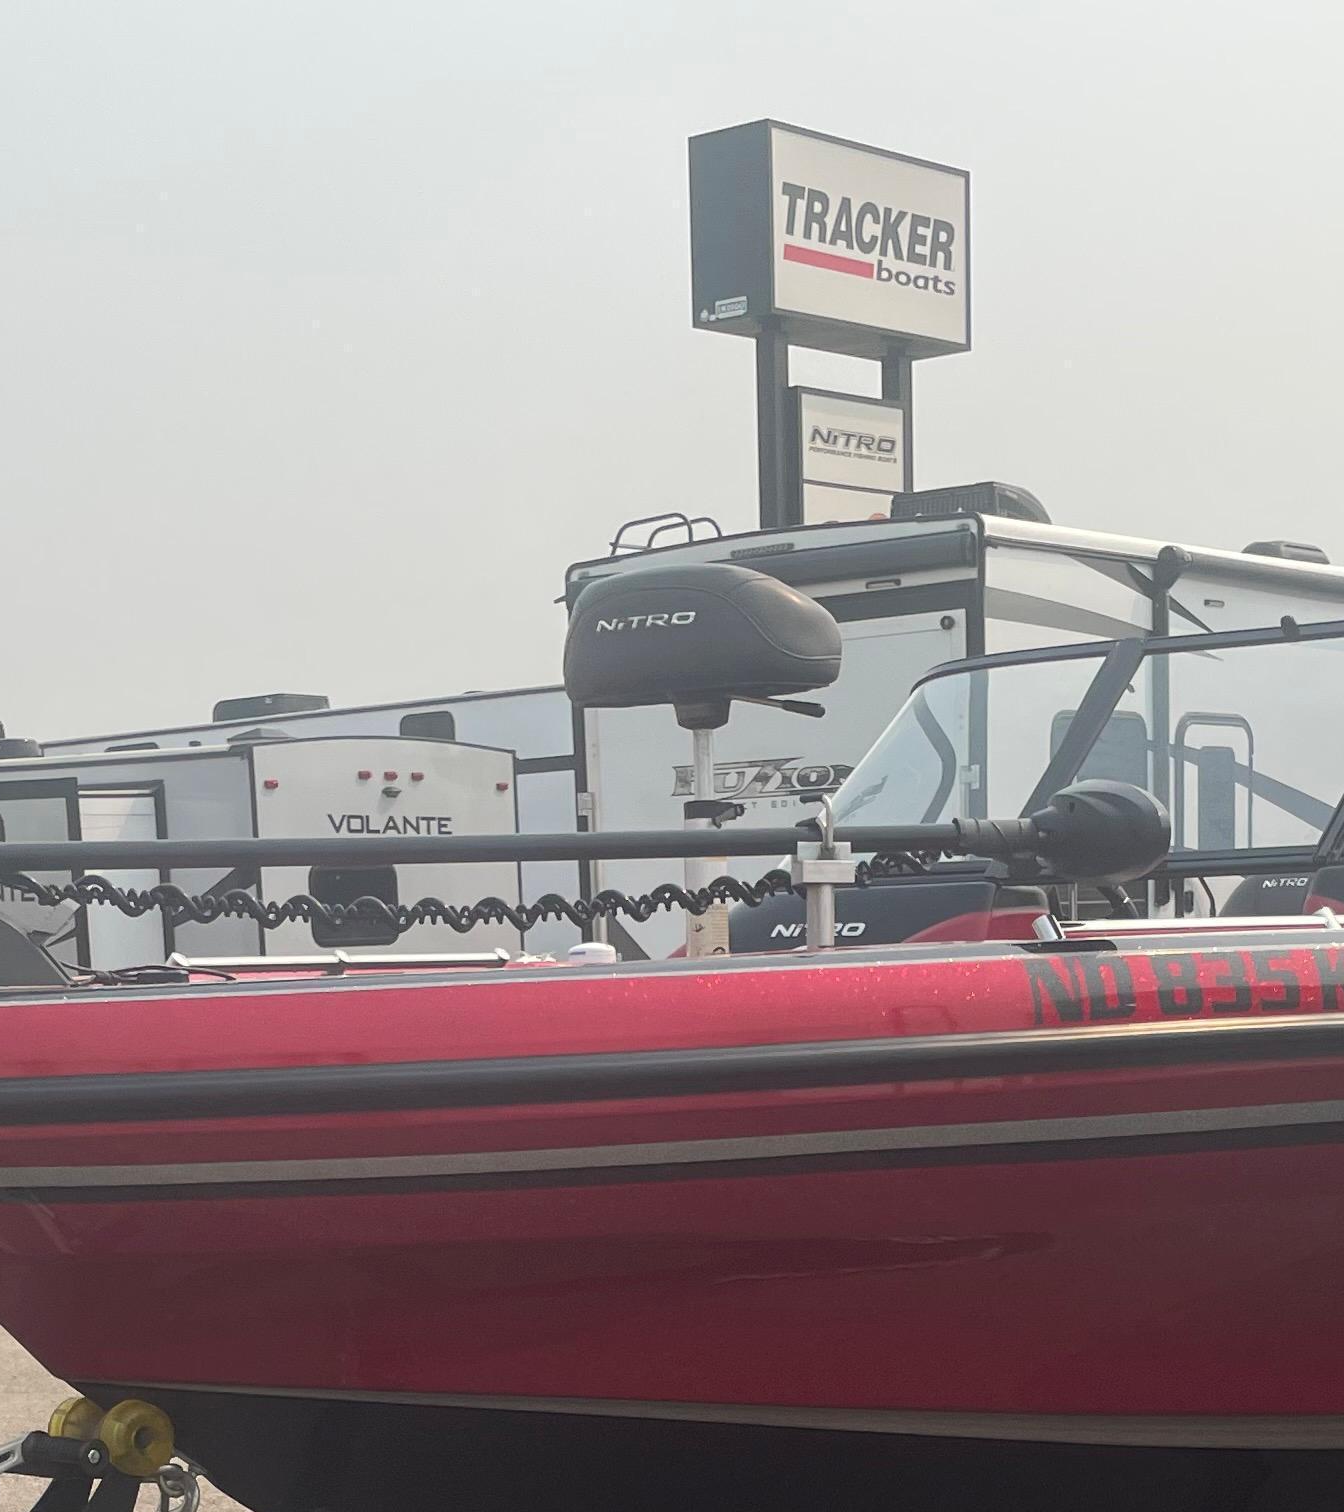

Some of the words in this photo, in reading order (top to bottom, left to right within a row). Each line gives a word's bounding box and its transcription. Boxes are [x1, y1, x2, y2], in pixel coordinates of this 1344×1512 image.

[782, 181, 956, 272] TRACKER
[876, 259, 956, 296] boats
[327, 814, 453, 835] VOLANTE
[1025, 955, 1137, 1025] ND
[1152, 949, 1301, 1017] 835
